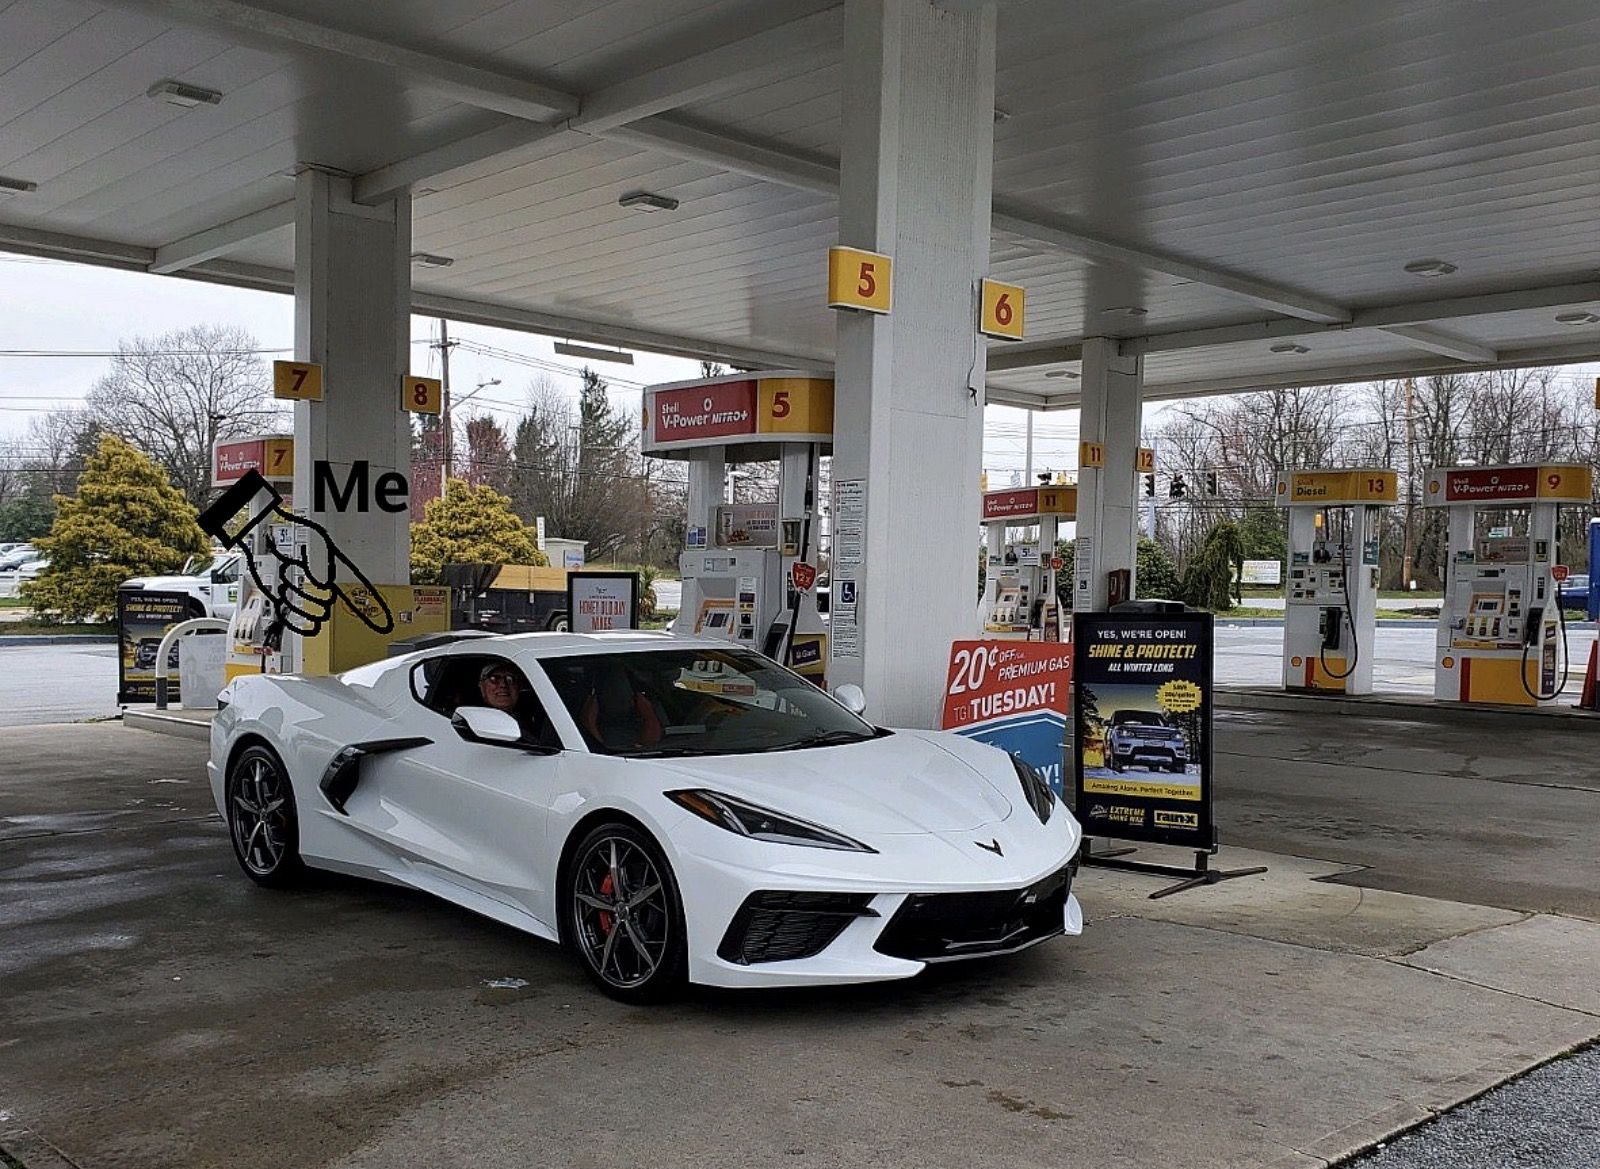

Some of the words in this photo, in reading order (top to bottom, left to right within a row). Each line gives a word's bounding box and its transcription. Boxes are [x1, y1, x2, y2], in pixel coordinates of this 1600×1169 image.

[858, 262, 876, 298] 5
[995, 293, 1013, 326] 6
[292, 369, 308, 392] 7
[414, 383, 428, 406] 8
[661, 402, 680, 414] Shell
[771, 391, 791, 418] 5
[662, 413, 710, 429] V-Power
[273, 449, 287, 467] 7
[1091, 447, 1101, 462] 11
[1141, 452, 1153, 468] 12
[1367, 479, 1385, 493] 13
[1547, 474, 1562, 489] 9
[1296, 486, 1327, 497] Diesel
[1453, 485, 1497, 494] V-Power
[1045, 495, 1056, 507] 11
[1097, 630, 1118, 640] YES,
[1121, 630, 1153, 639] WE'RE
[1155, 630, 1187, 639] OPEN!
[1088, 644, 1123, 658] SHINE
[1124, 644, 1135, 658] &
[1136, 645, 1197, 659] PROTECT!
[998, 659, 1048, 681] PREMIUM
[1049, 656, 1070, 671] GAS
[1108, 662, 1122, 672] ALL
[1123, 663, 1153, 673] WINTER
[1153, 663, 1174, 673] LONG
[970, 682, 1055, 720] TUESDAY!
[1110, 806, 1145, 817] EXTREME
